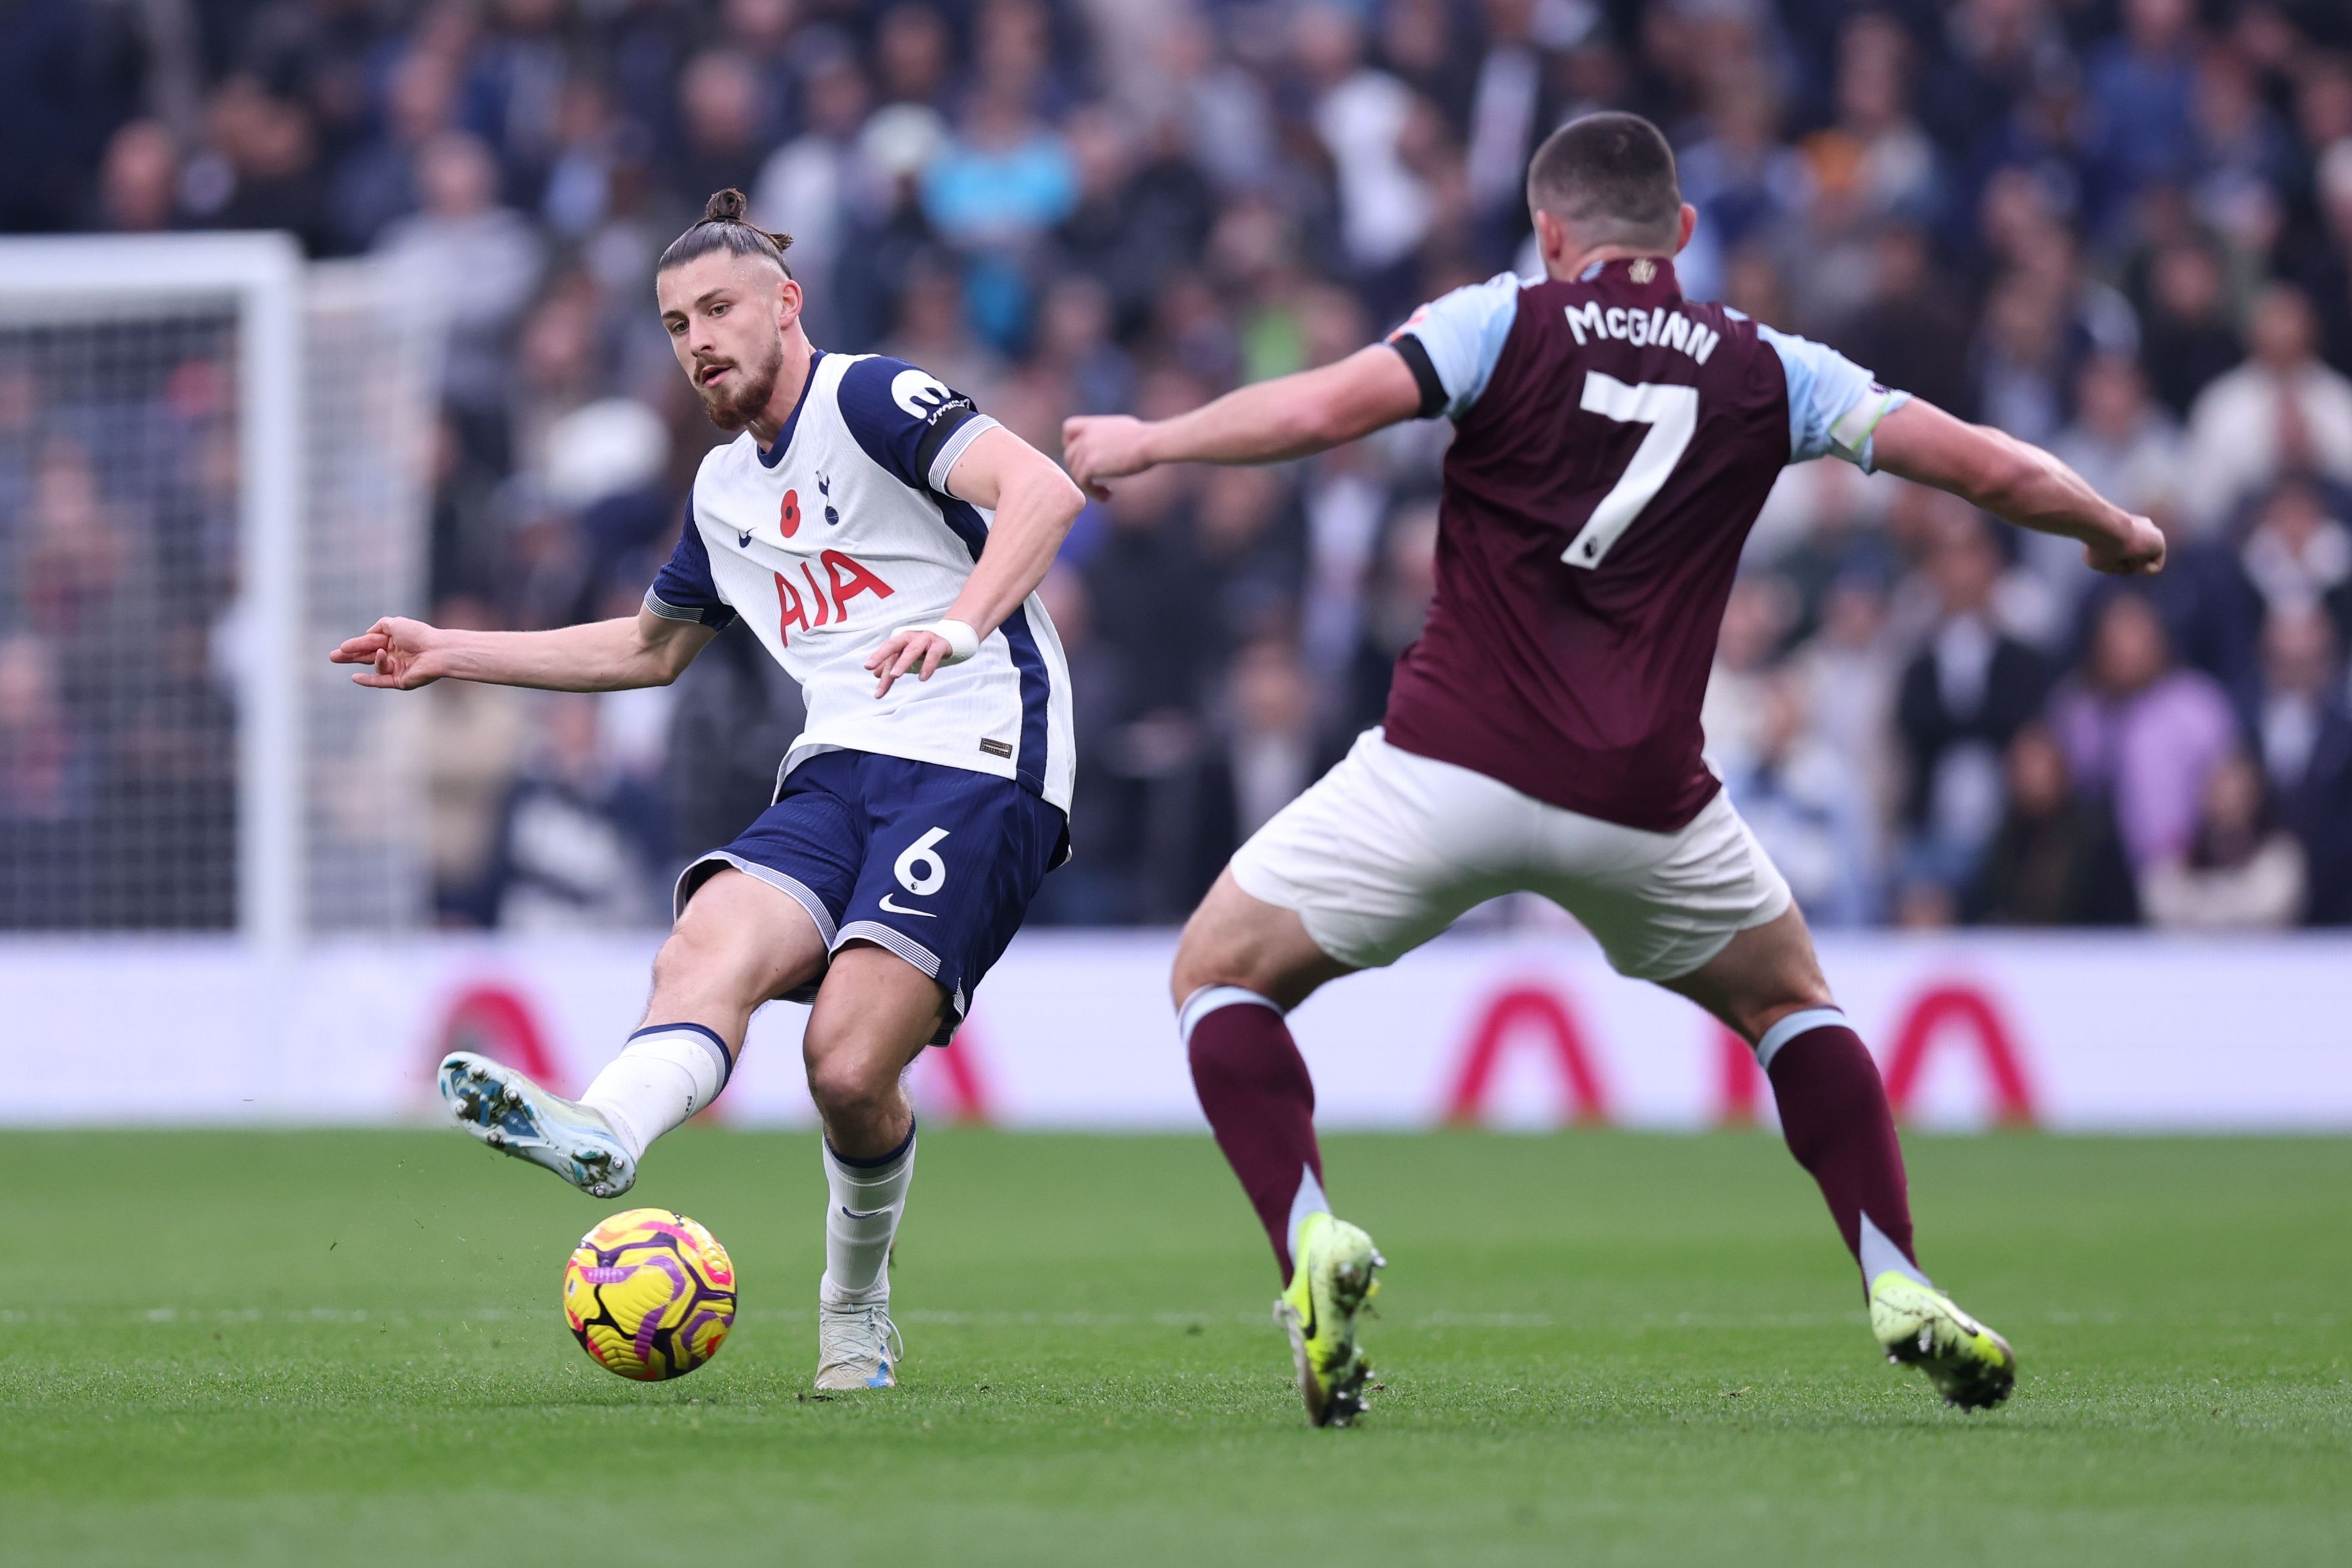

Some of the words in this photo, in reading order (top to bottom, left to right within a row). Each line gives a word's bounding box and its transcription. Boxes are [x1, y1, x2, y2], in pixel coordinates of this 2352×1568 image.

[1561, 370, 1699, 570] 7
[774, 549, 895, 649] AIA
[893, 826, 950, 896] 6
